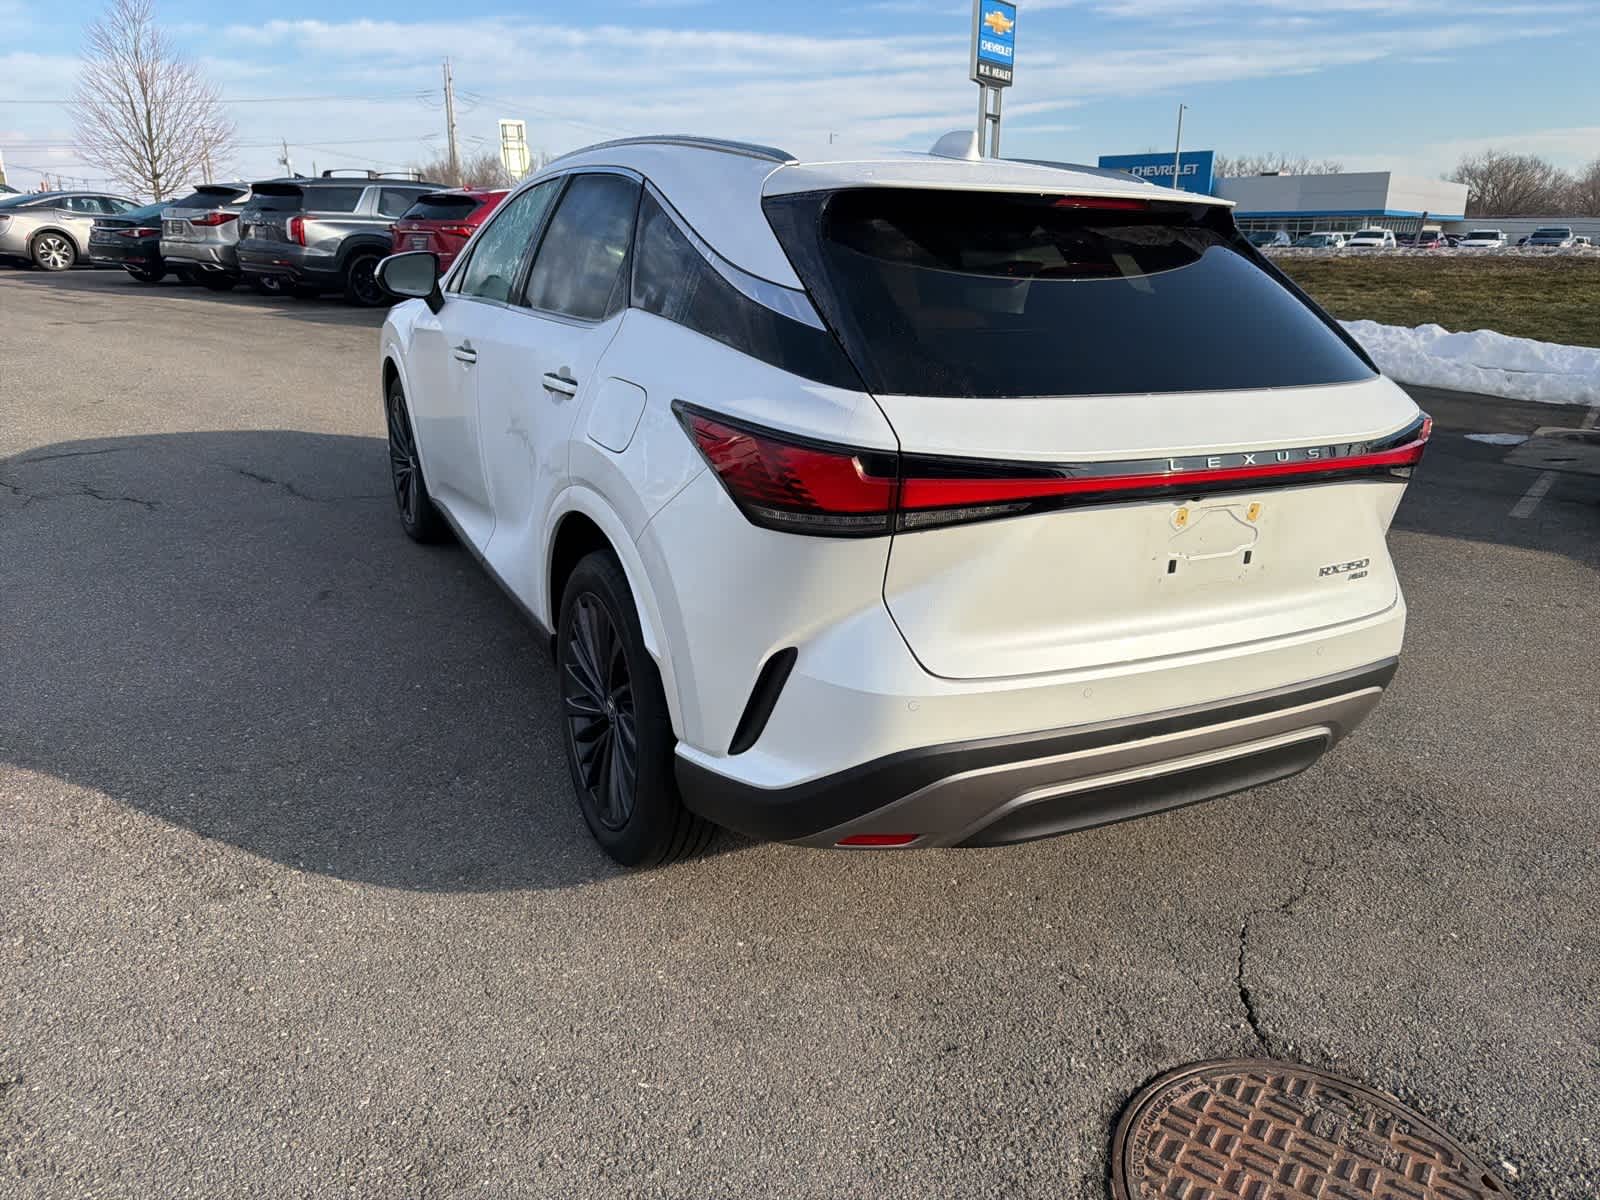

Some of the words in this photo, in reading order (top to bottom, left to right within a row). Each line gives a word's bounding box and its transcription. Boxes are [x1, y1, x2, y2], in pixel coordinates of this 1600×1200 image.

[981, 40, 1013, 57] CHEVROLET
[1131, 164, 1199, 176] CHEVROLET
[1168, 448, 1321, 471] LEXUS
